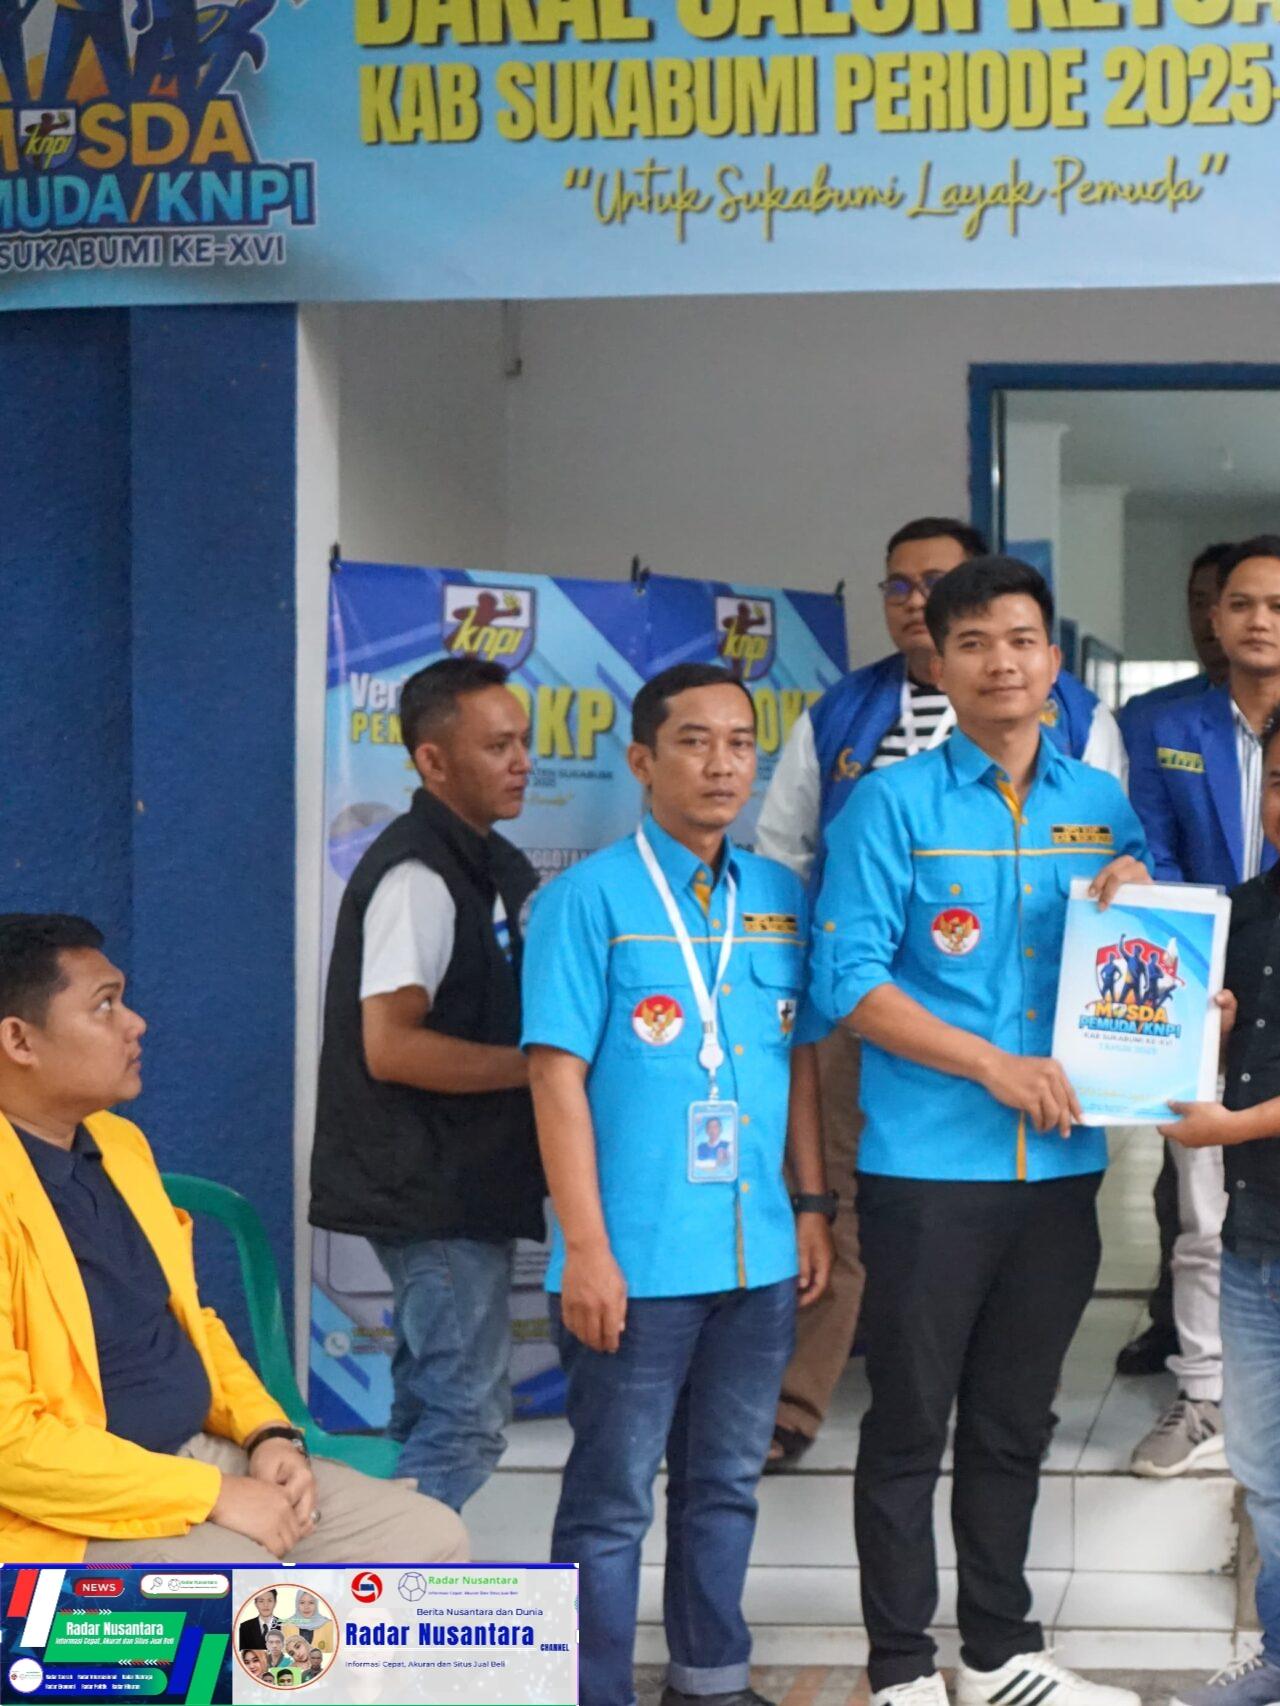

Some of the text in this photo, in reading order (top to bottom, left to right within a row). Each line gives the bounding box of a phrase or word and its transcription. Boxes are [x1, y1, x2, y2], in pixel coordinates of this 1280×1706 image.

[359, 63, 479, 144] KAB
[496, 54, 818, 141] SUKABUMI
[834, 48, 1086, 133] PERIODE
[715, 161, 903, 243] Sukabumi
[906, 156, 1047, 241] Layak
[170, 234, 286, 266] KE-XVI
[451, 607, 525, 663] knpi
